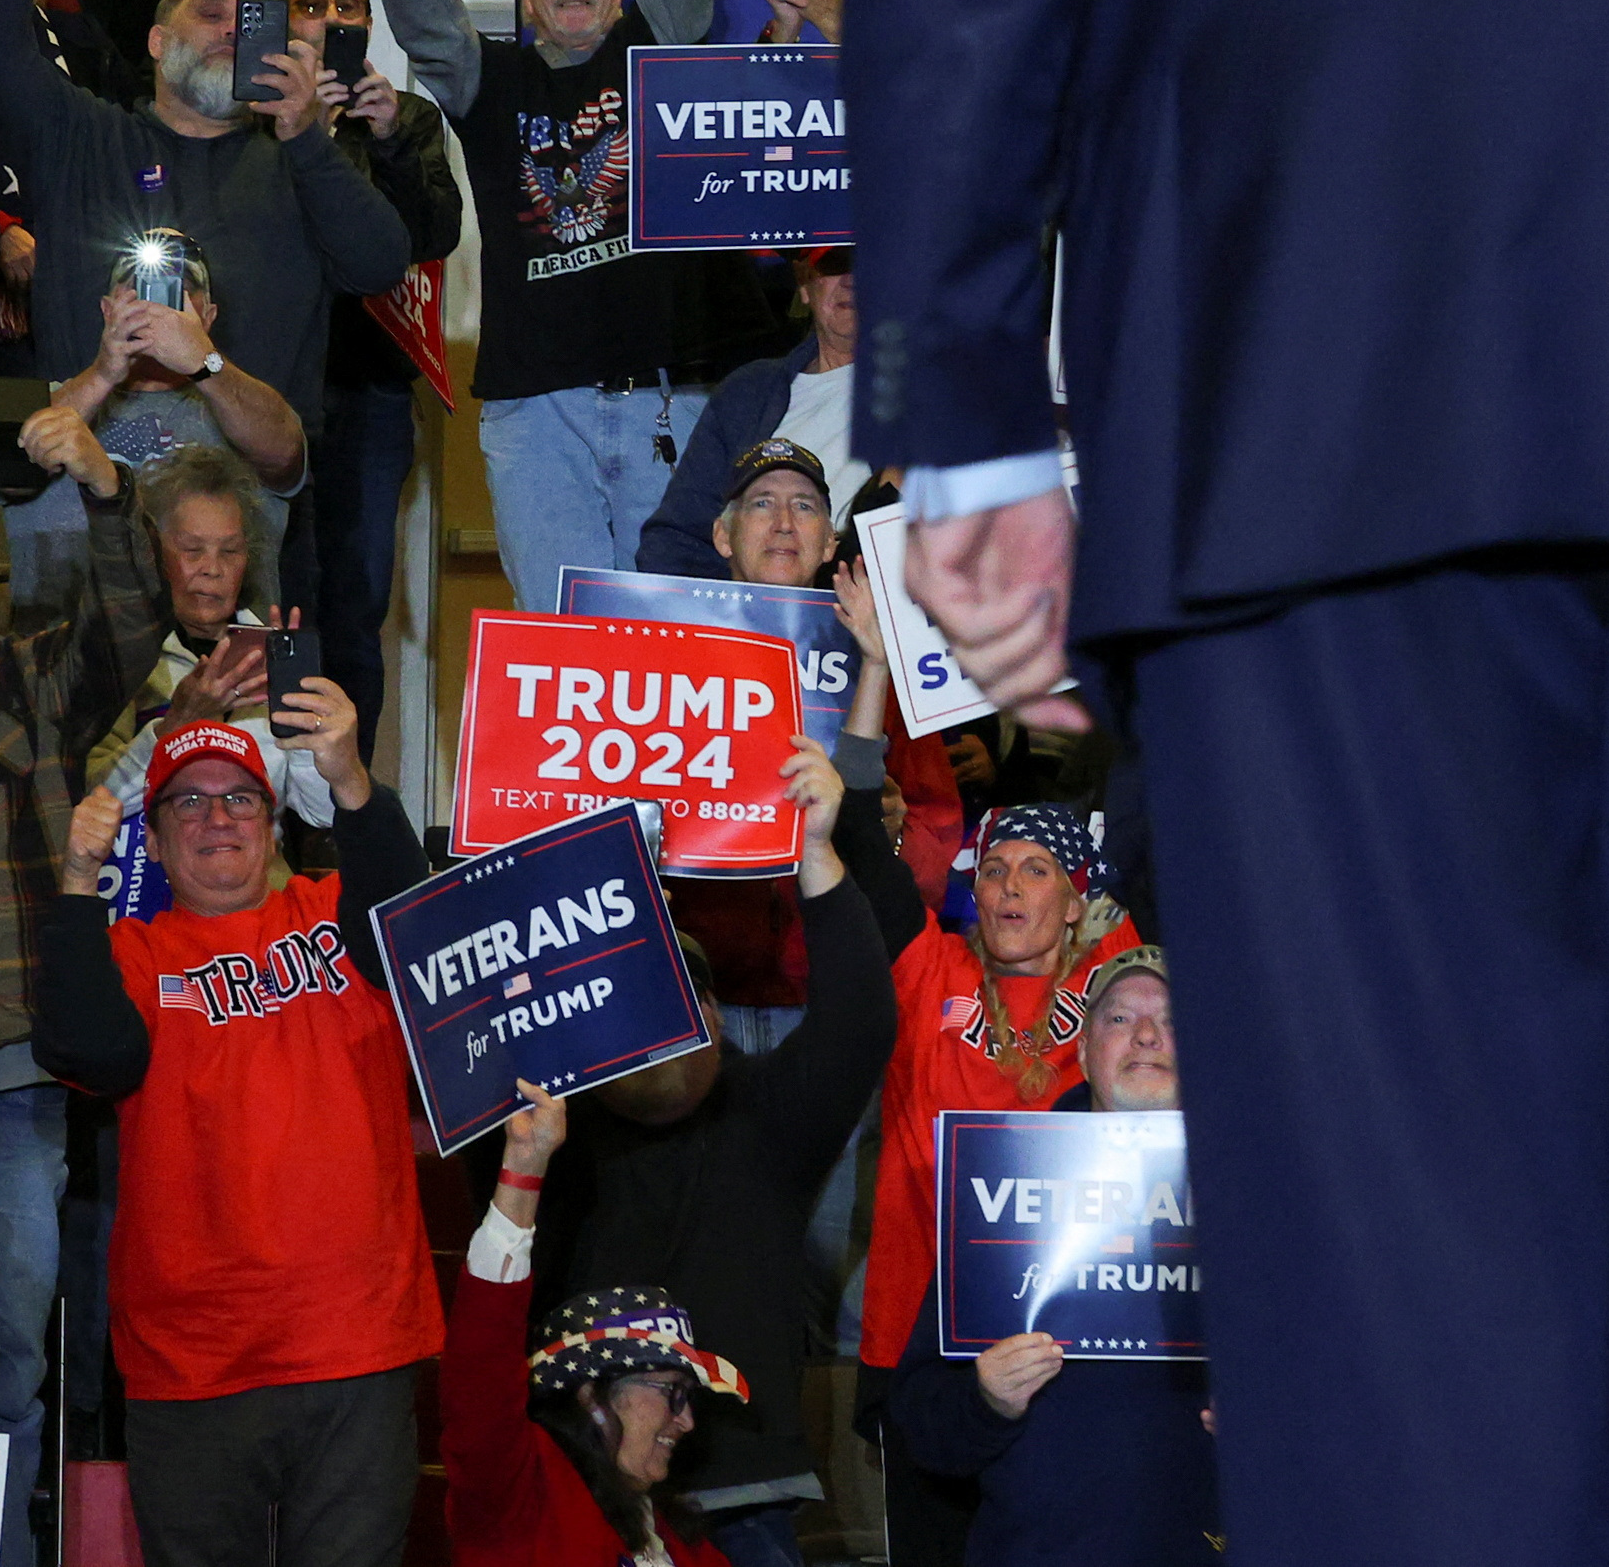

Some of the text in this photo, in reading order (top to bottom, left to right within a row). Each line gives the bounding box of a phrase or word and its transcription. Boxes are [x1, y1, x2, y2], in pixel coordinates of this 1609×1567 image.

[694, 171, 735, 203] for
[531, 248, 603, 277] AMERICA
[505, 662, 776, 733] TRUMP
[164, 727, 249, 755] MAKE AMERICA
[170, 737, 247, 762] GREAT AGAIN
[536, 728, 736, 790] 2024
[491, 788, 556, 811] TEXT
[697, 800, 777, 824] 88022
[125, 844, 147, 917] TRUMP
[408, 877, 637, 1006] VETERANS
[183, 919, 353, 1027] TRUMP
[465, 975, 615, 1075] for TRUMP
